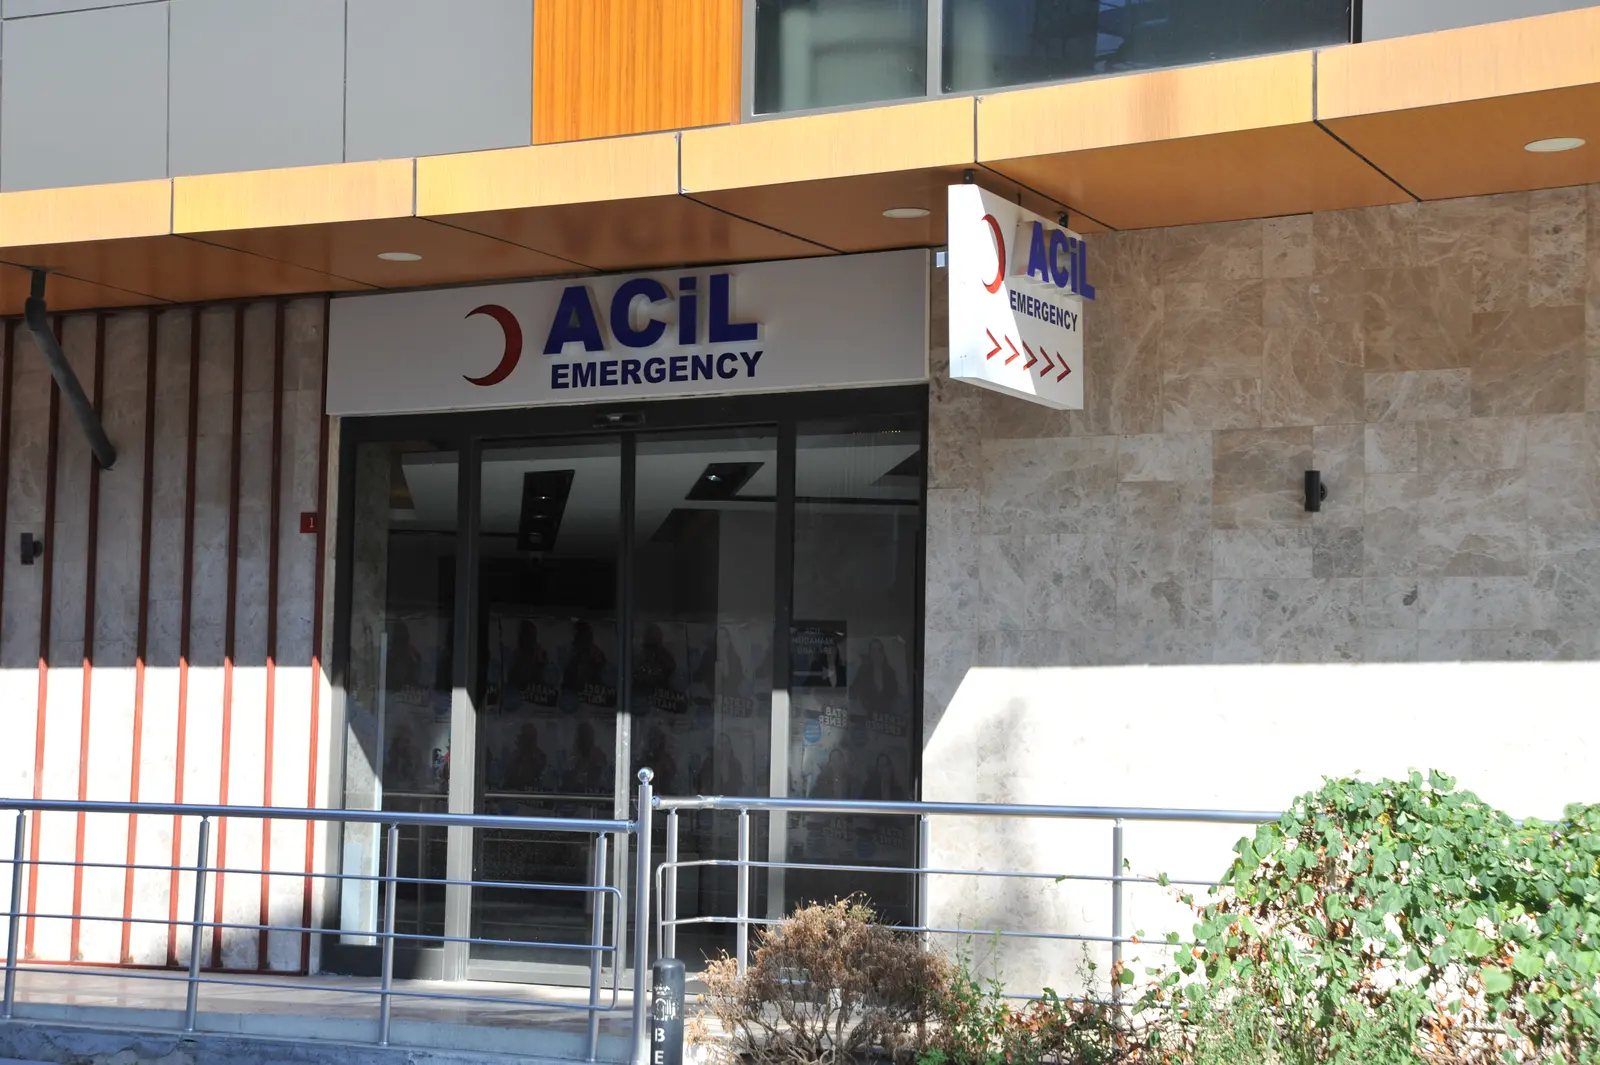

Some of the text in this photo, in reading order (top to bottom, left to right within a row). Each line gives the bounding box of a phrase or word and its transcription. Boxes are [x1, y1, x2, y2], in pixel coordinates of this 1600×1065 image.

[1009, 289, 1078, 332] EMERGENCY
[551, 350, 764, 389] EMERGENCY
[309, 517, 315, 529] 1
